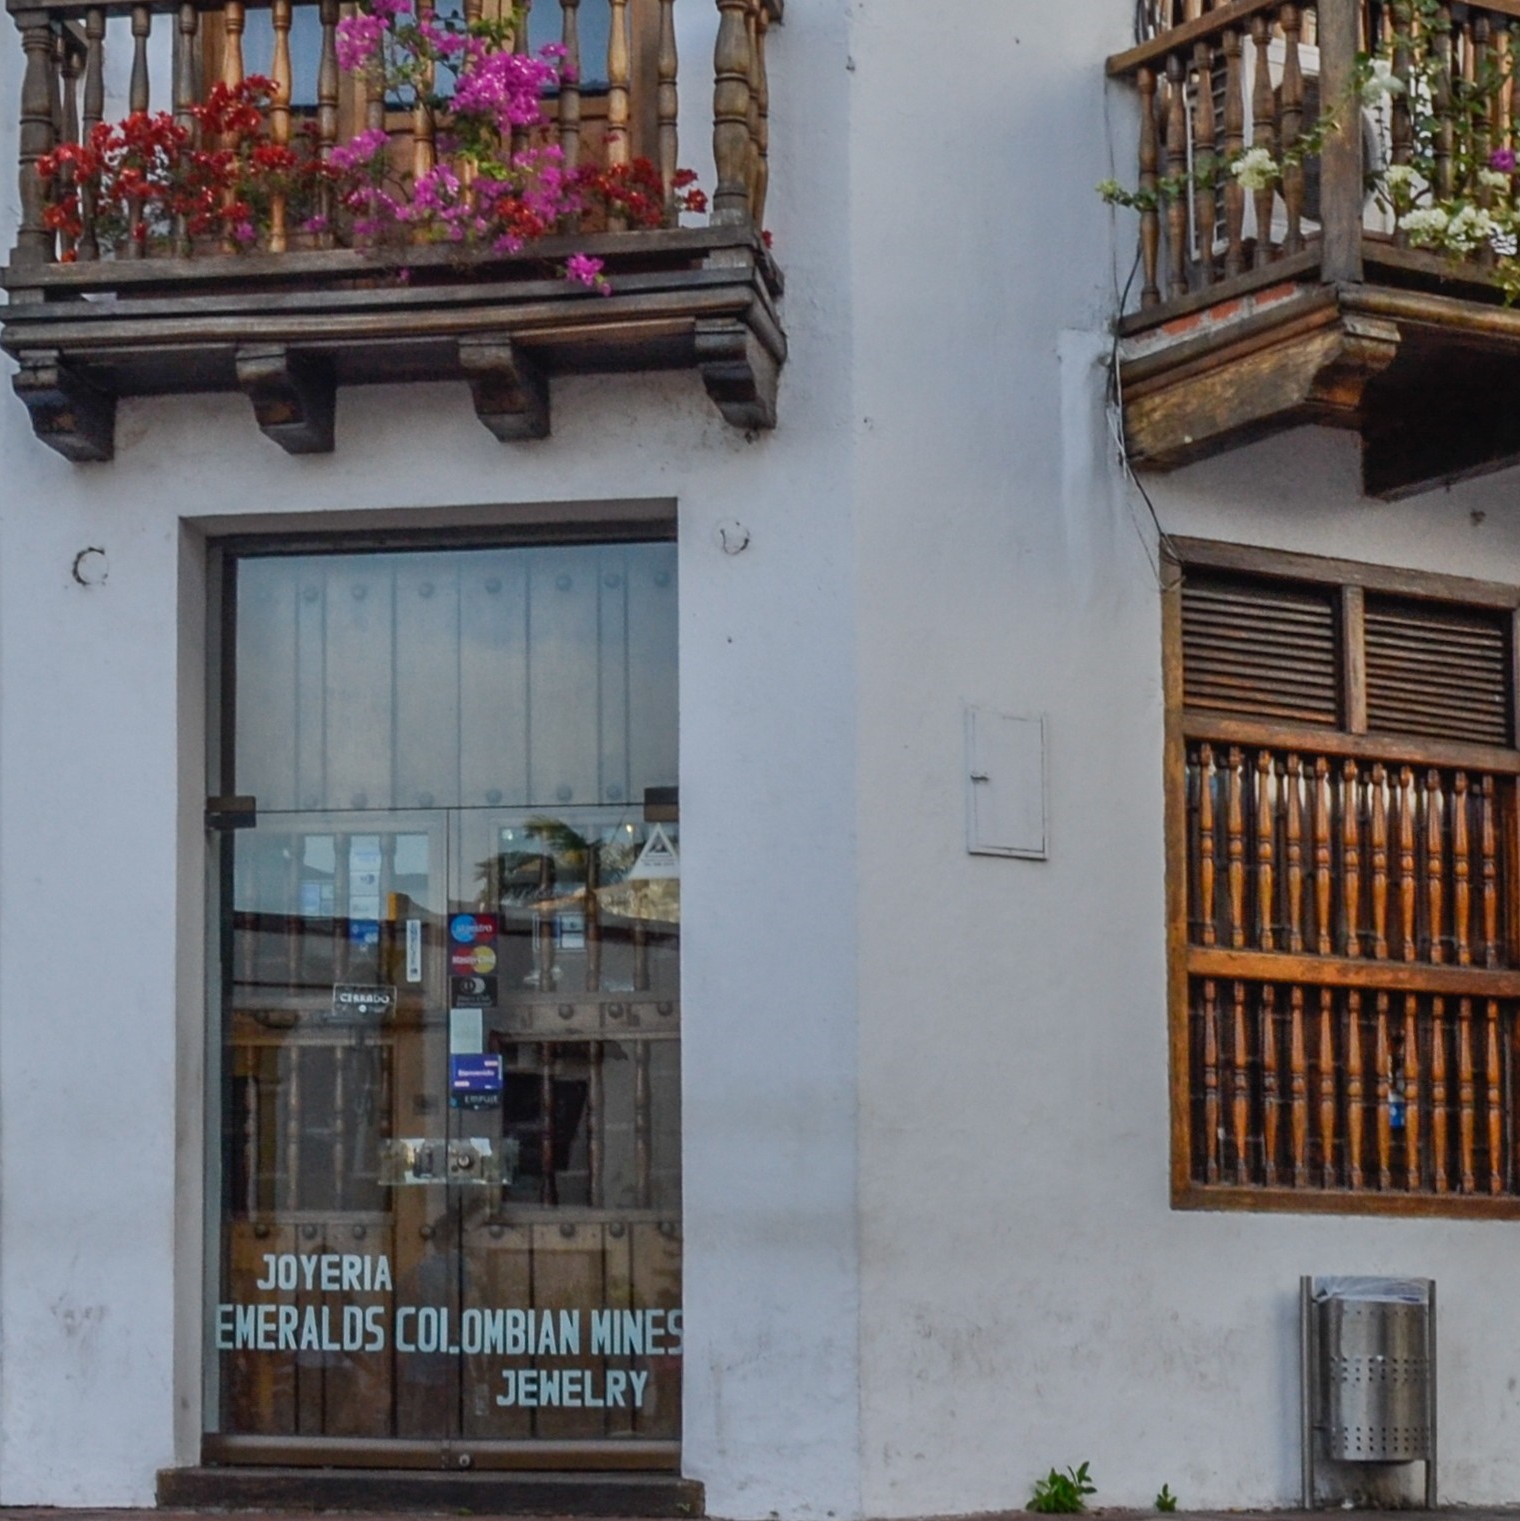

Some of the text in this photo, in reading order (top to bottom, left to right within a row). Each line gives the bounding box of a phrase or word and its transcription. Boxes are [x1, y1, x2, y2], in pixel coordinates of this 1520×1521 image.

[256, 1253, 393, 1292] JOYERIA
[215, 1303, 684, 1356] EMERALDS COLOMBIAN MINES
[495, 1369, 648, 1408] JEWELRY
